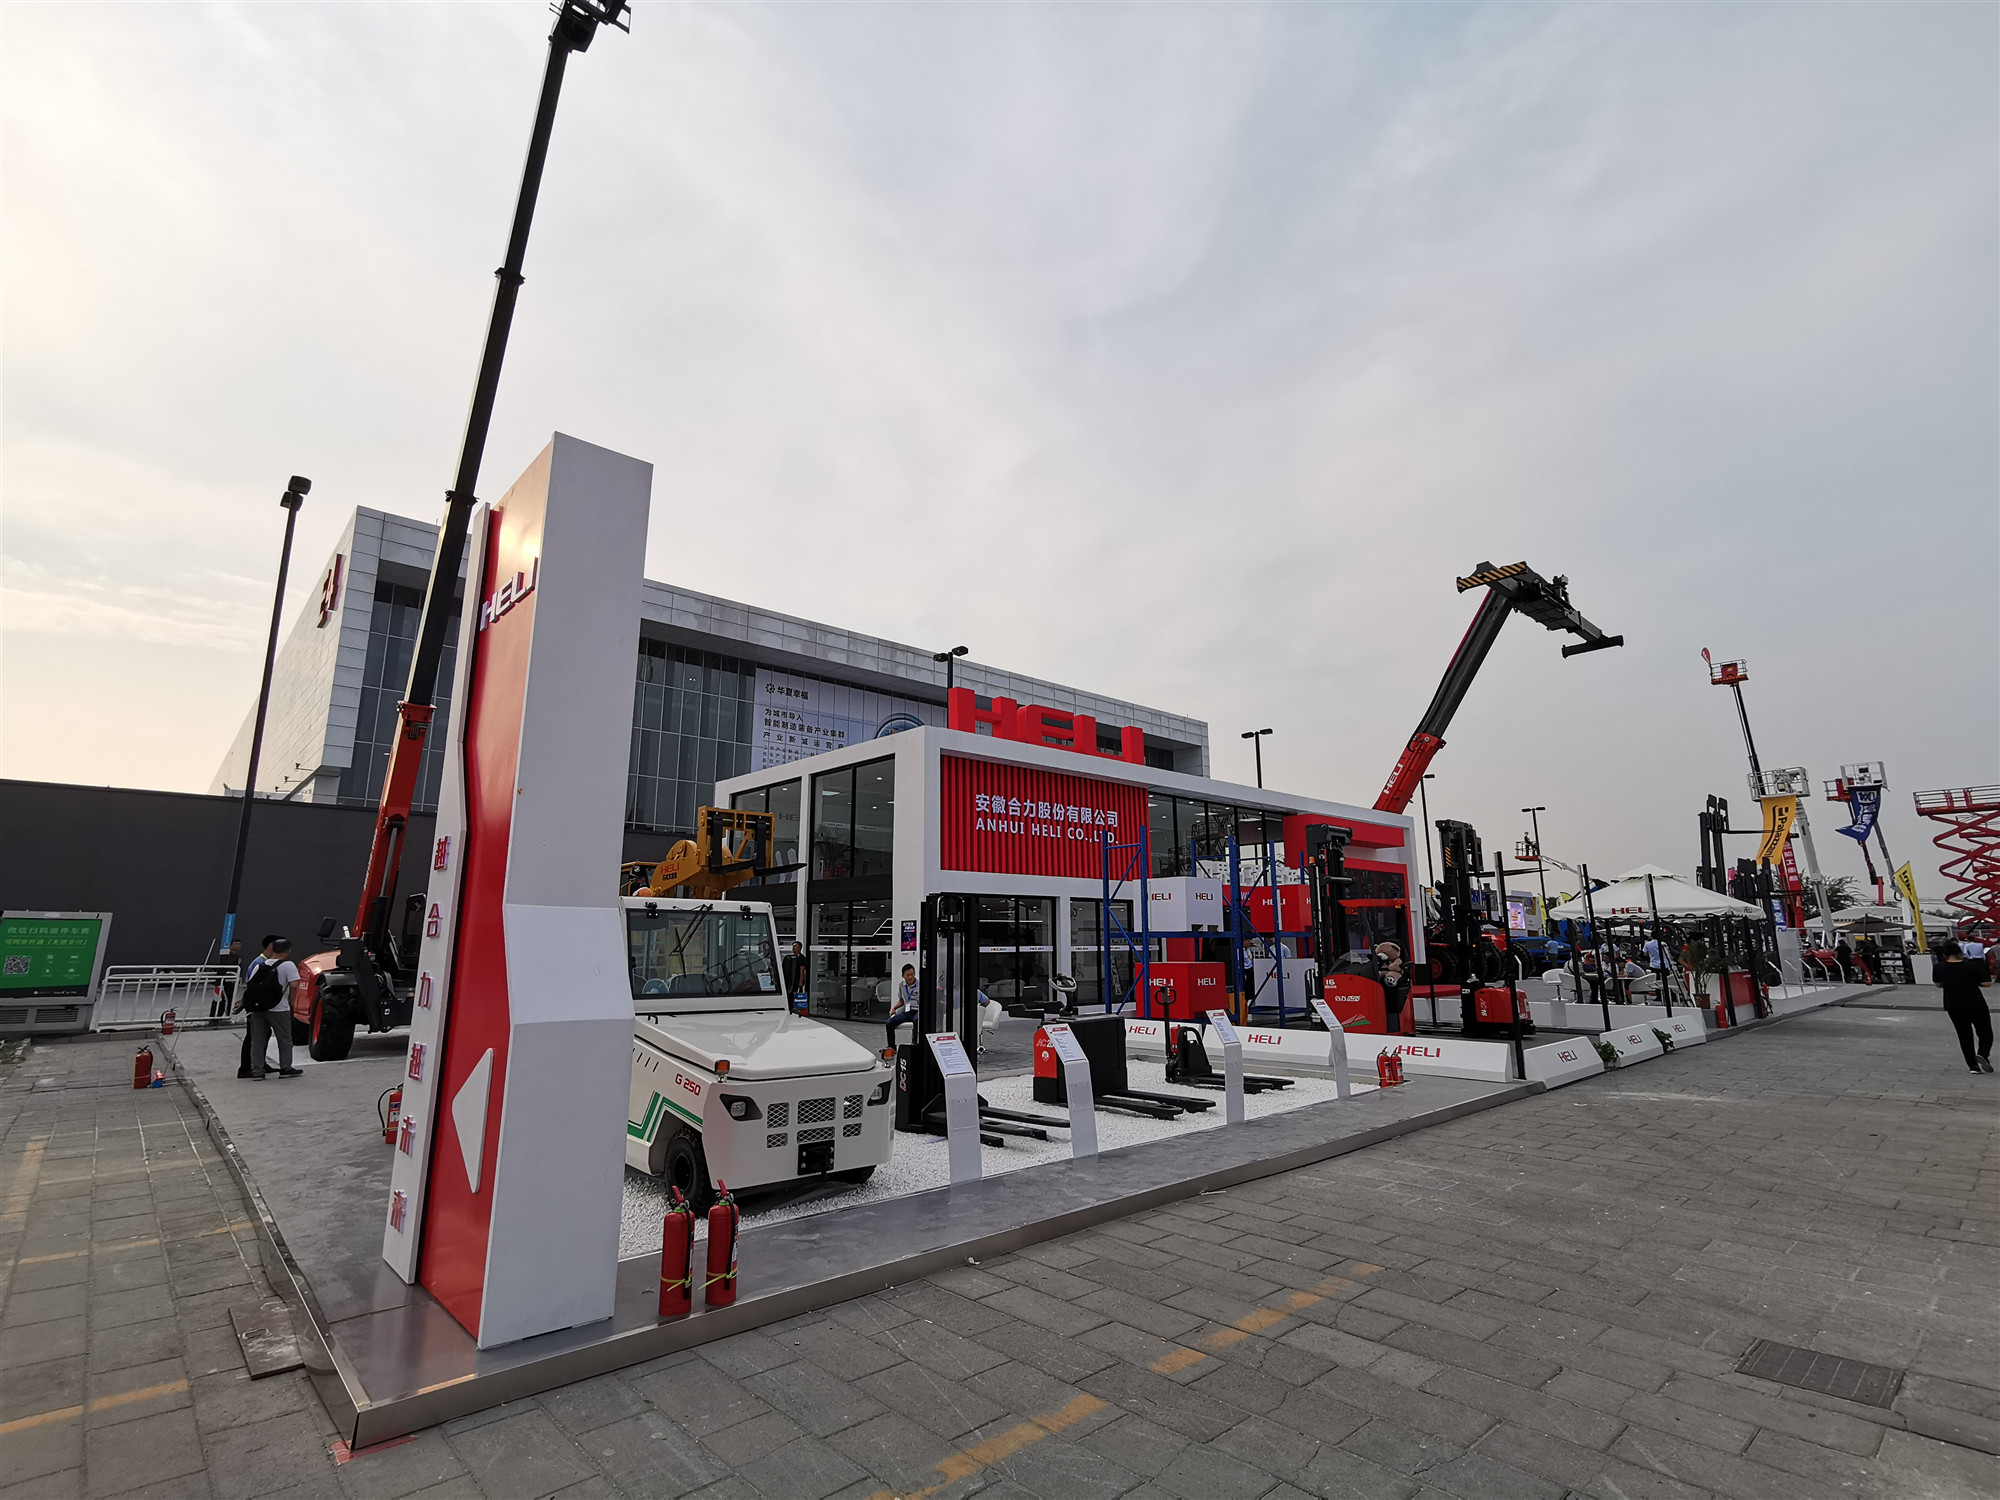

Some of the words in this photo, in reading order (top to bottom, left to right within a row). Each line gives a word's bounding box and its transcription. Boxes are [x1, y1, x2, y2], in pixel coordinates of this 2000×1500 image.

[480, 556, 539, 631] HELI
[777, 686, 809, 700] 华夏幸福
[765, 708, 803, 722] 为城市导入
[764, 718, 845, 739] 智能制造装备产业集群
[948, 687, 1145, 765] HELI
[1383, 763, 1403, 794] HELI
[976, 793, 1118, 827] 安徽合力股份有限公司
[976, 817, 1025, 834] ANHUI
[1031, 823, 1061, 838] HELI
[1067, 828, 1119, 844] CO.,LD.
[660, 862, 680, 874] HELI
[1195, 892, 1213, 901] HELI
[1262, 898, 1286, 906] HEI
[1197, 977, 1216, 986] HELI
[1129, 1025, 1157, 1036] HELI
[1672, 1023, 1686, 1034] HELI
[1248, 1034, 1282, 1045] HELI
[1626, 1034, 1641, 1045] HELI
[1398, 1045, 1441, 1058] HELI
[1558, 1050, 1578, 1063] HELI
[683, 1078, 702, 1096] 250
